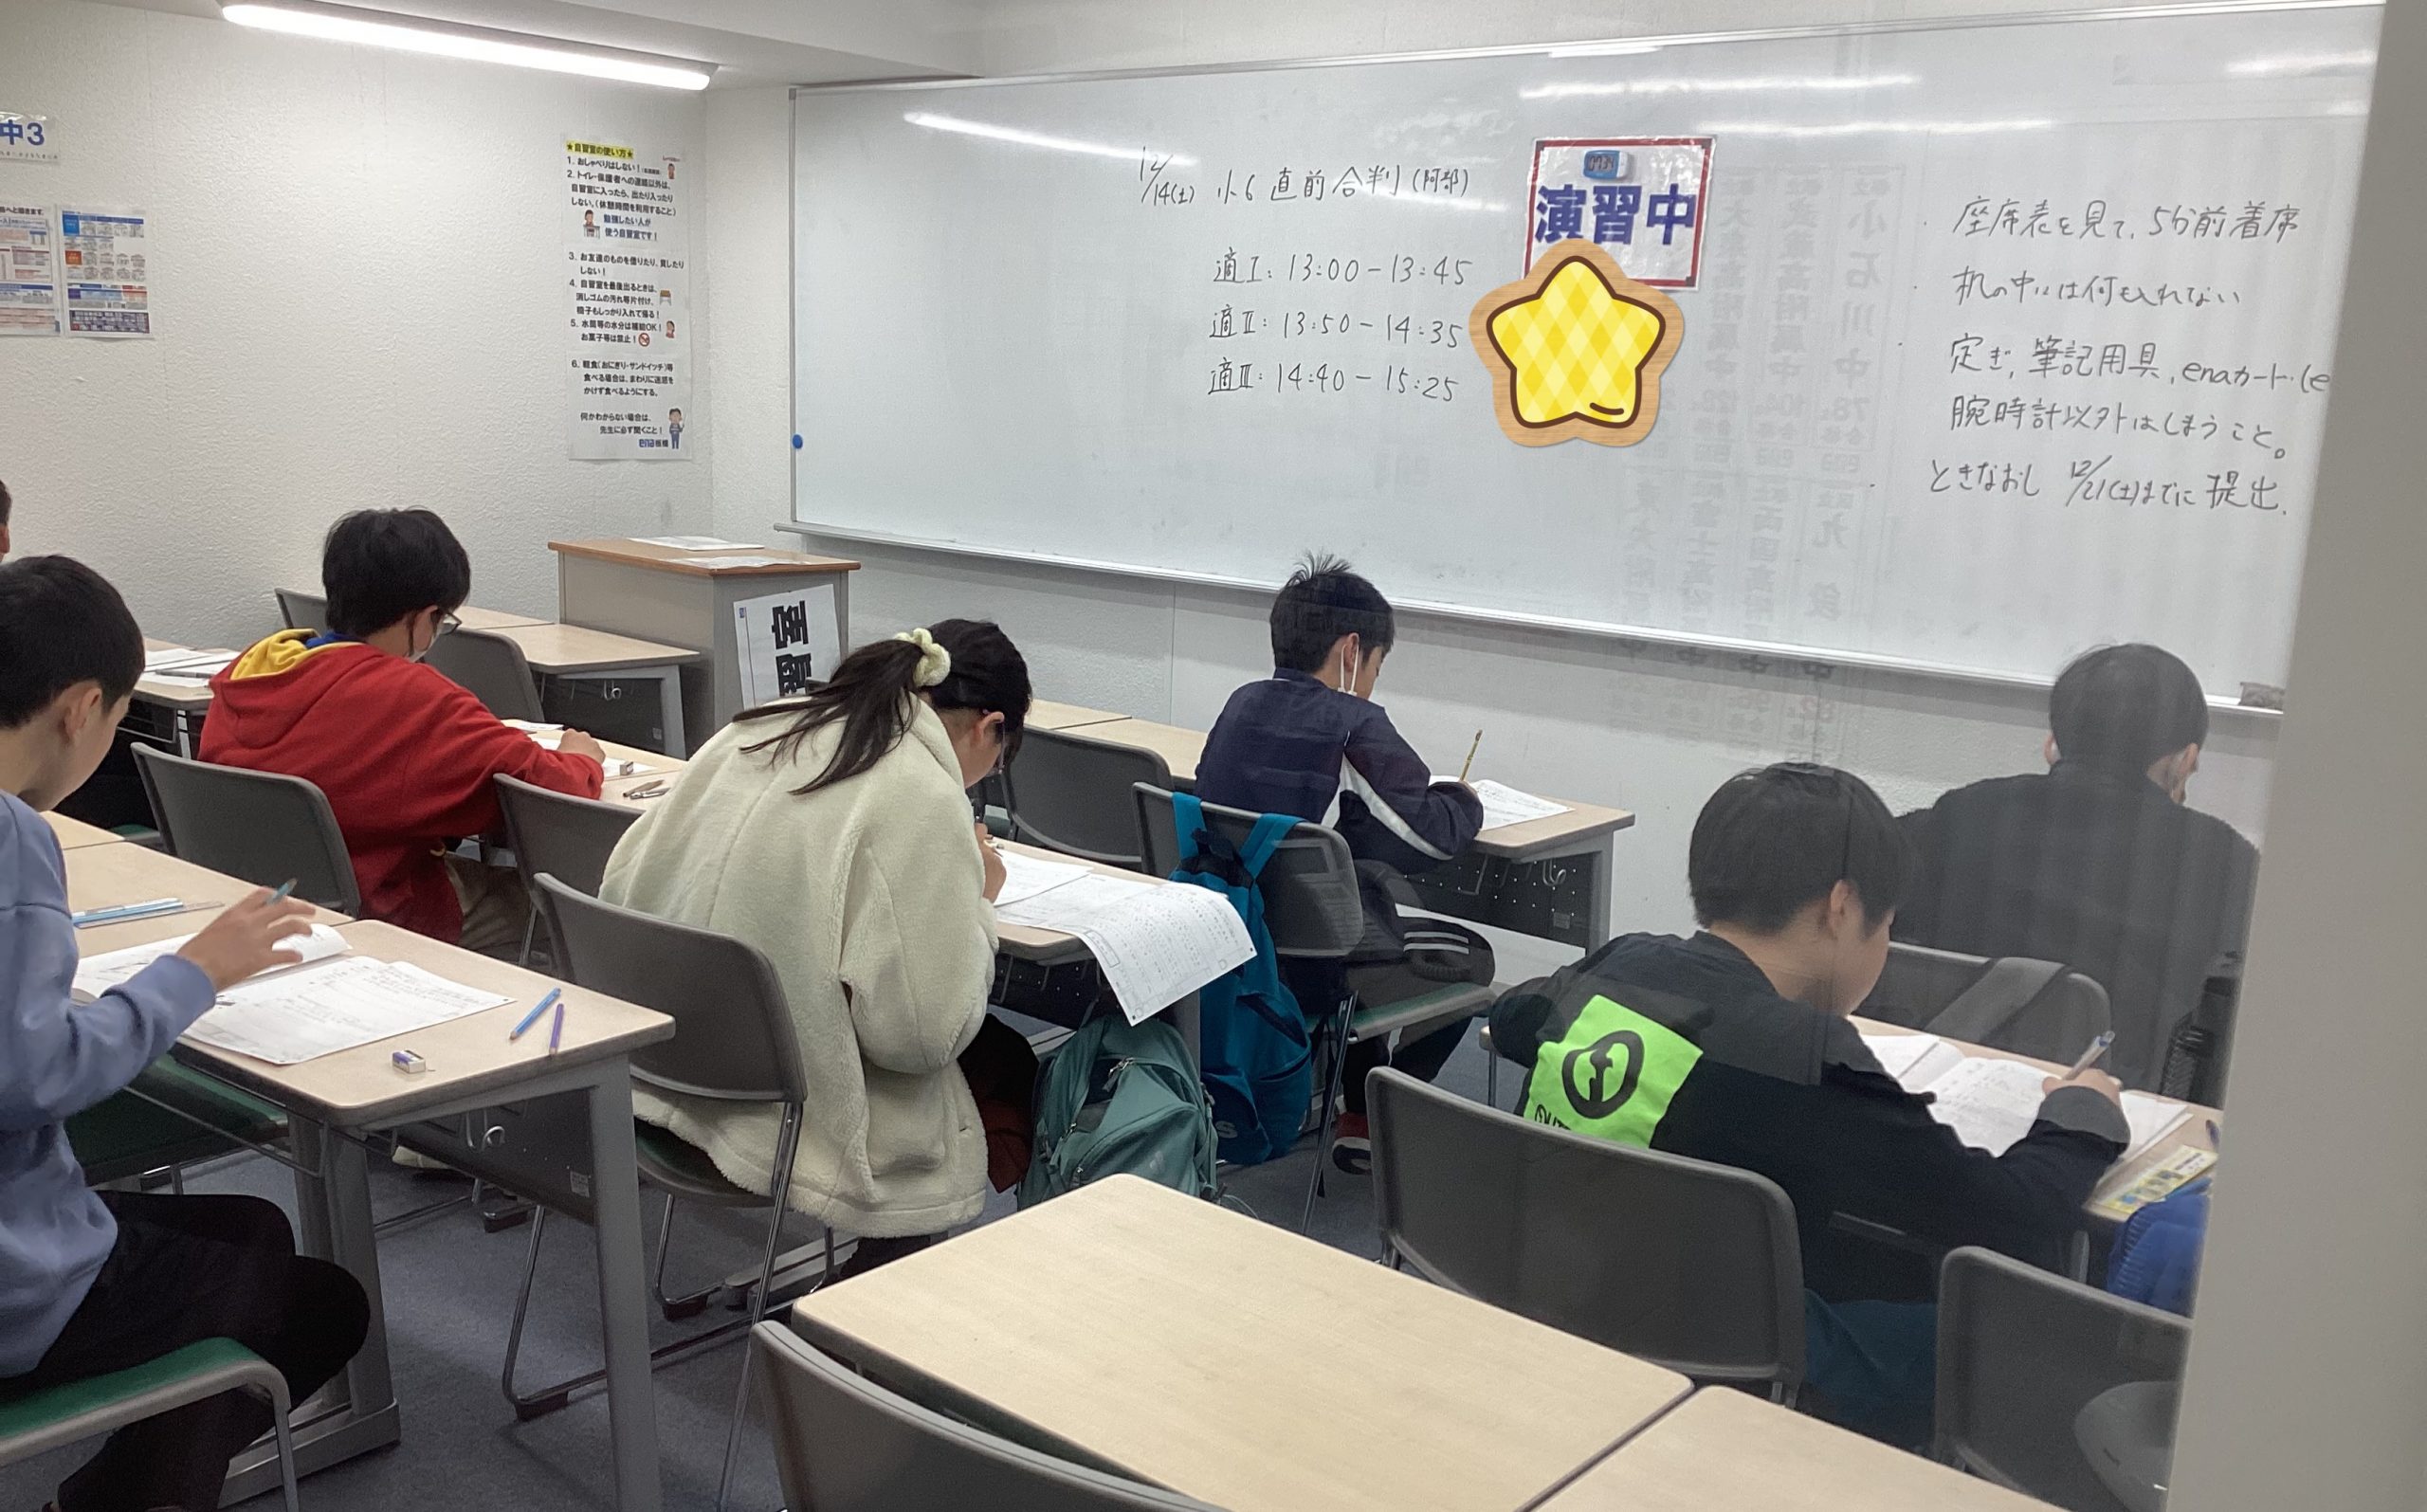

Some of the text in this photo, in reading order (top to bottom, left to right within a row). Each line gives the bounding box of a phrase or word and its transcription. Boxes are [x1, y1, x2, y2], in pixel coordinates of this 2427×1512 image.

[1217, 169, 1255, 205] 小6
[1534, 183, 1697, 246] 演習中
